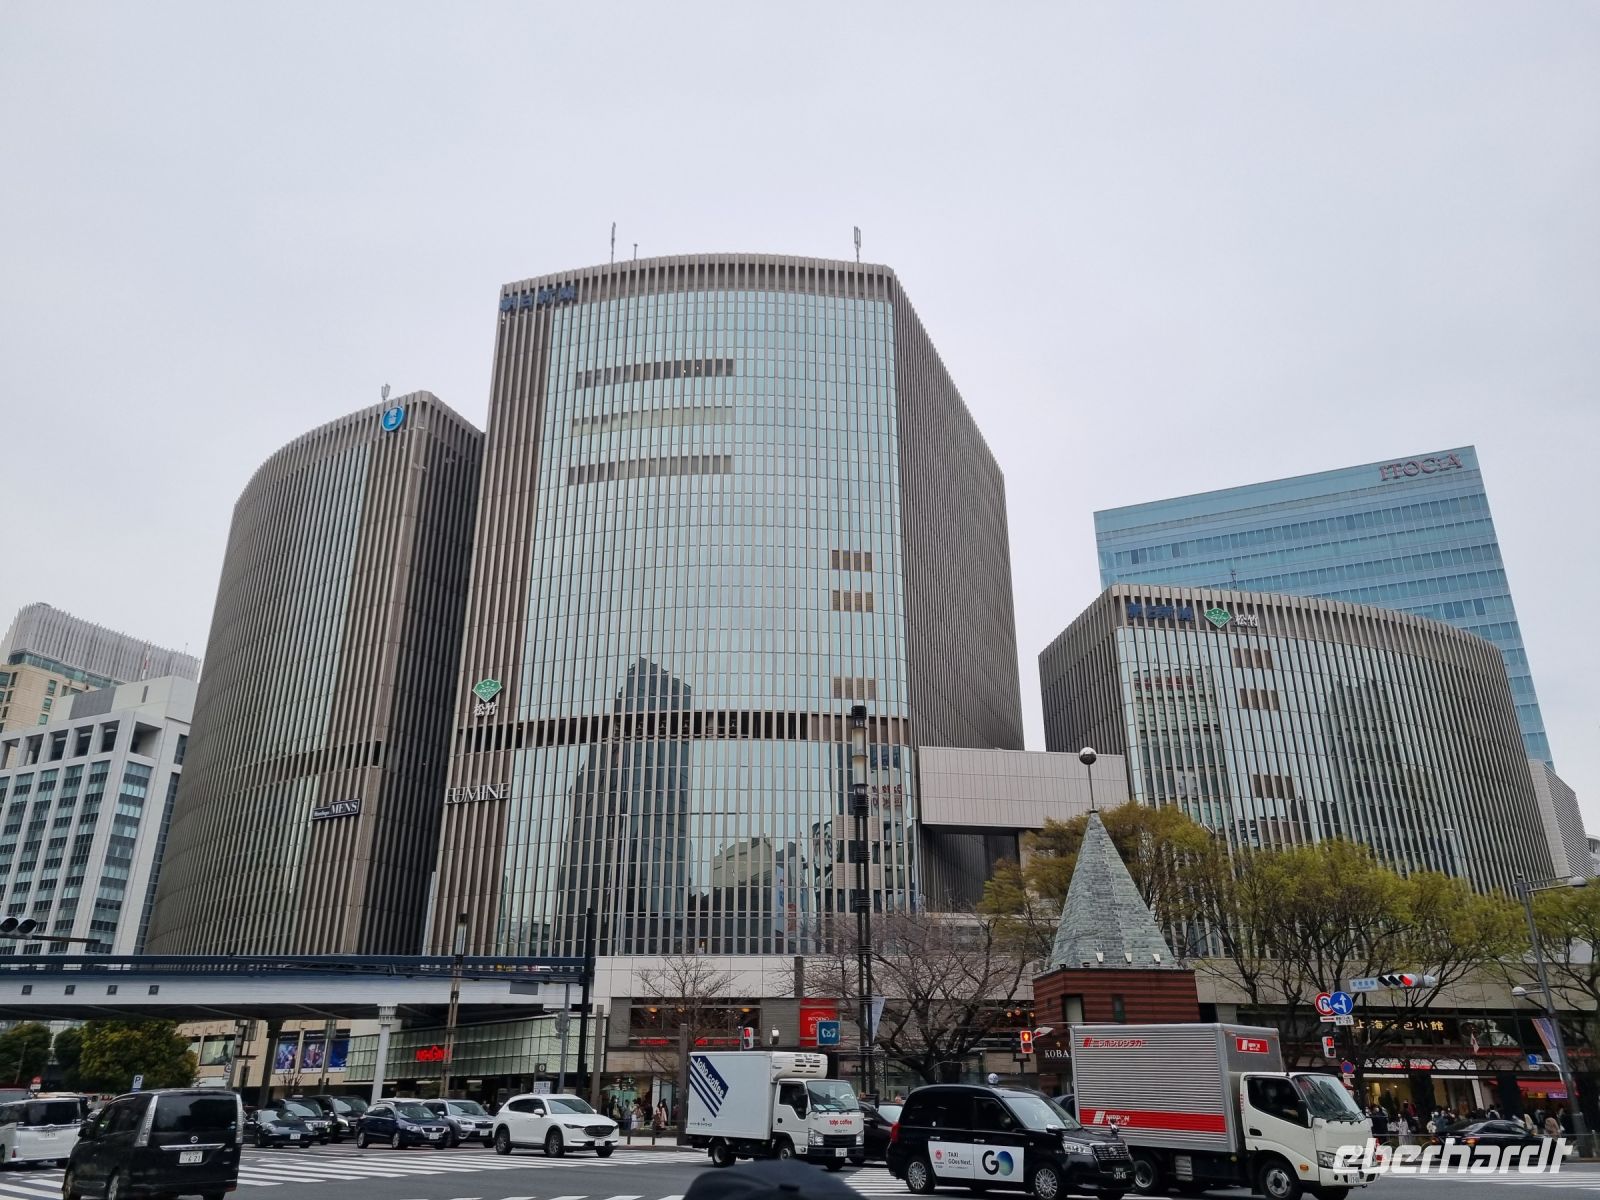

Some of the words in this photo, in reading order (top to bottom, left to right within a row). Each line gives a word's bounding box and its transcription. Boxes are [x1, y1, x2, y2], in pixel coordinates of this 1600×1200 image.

[444, 783, 509, 804] LUMINE
[1355, 1020, 1445, 1031] 上海包小館
[1045, 1050, 1071, 1058] KOBA
